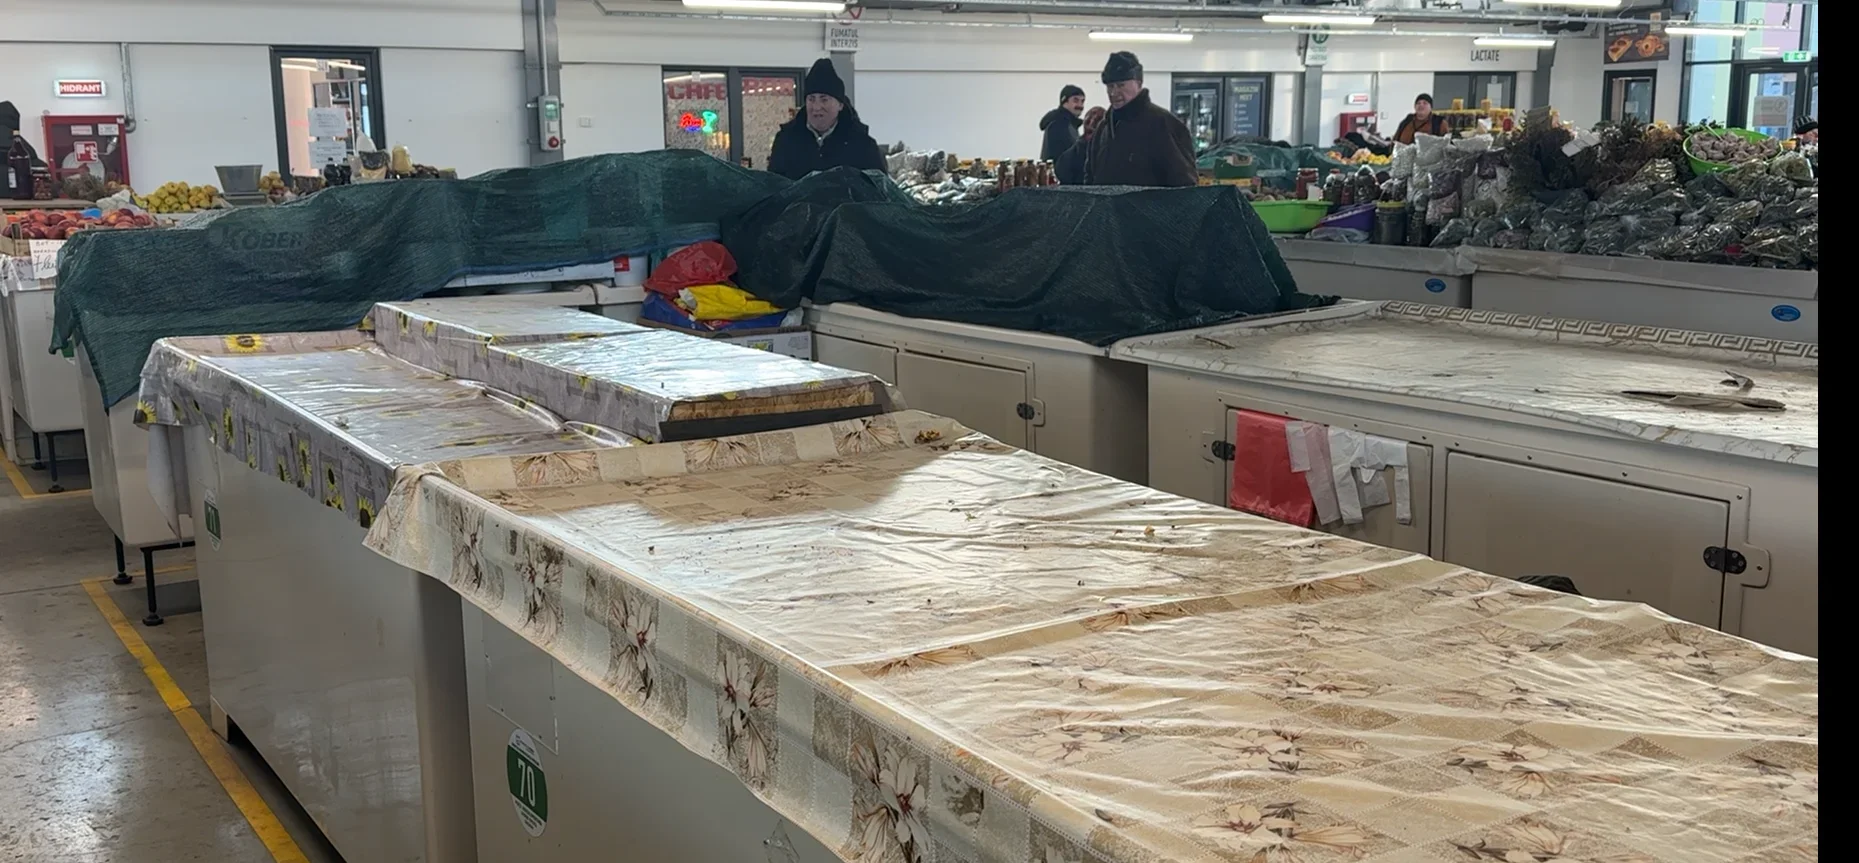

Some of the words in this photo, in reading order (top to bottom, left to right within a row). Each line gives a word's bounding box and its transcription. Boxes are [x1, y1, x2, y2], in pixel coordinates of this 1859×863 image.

[830, 28, 859, 38] FUMATUL
[830, 39, 859, 48] INTERZIS
[1470, 49, 1500, 62] LACTATE
[60, 84, 101, 93] HIDRANT
[517, 758, 536, 807] 70
